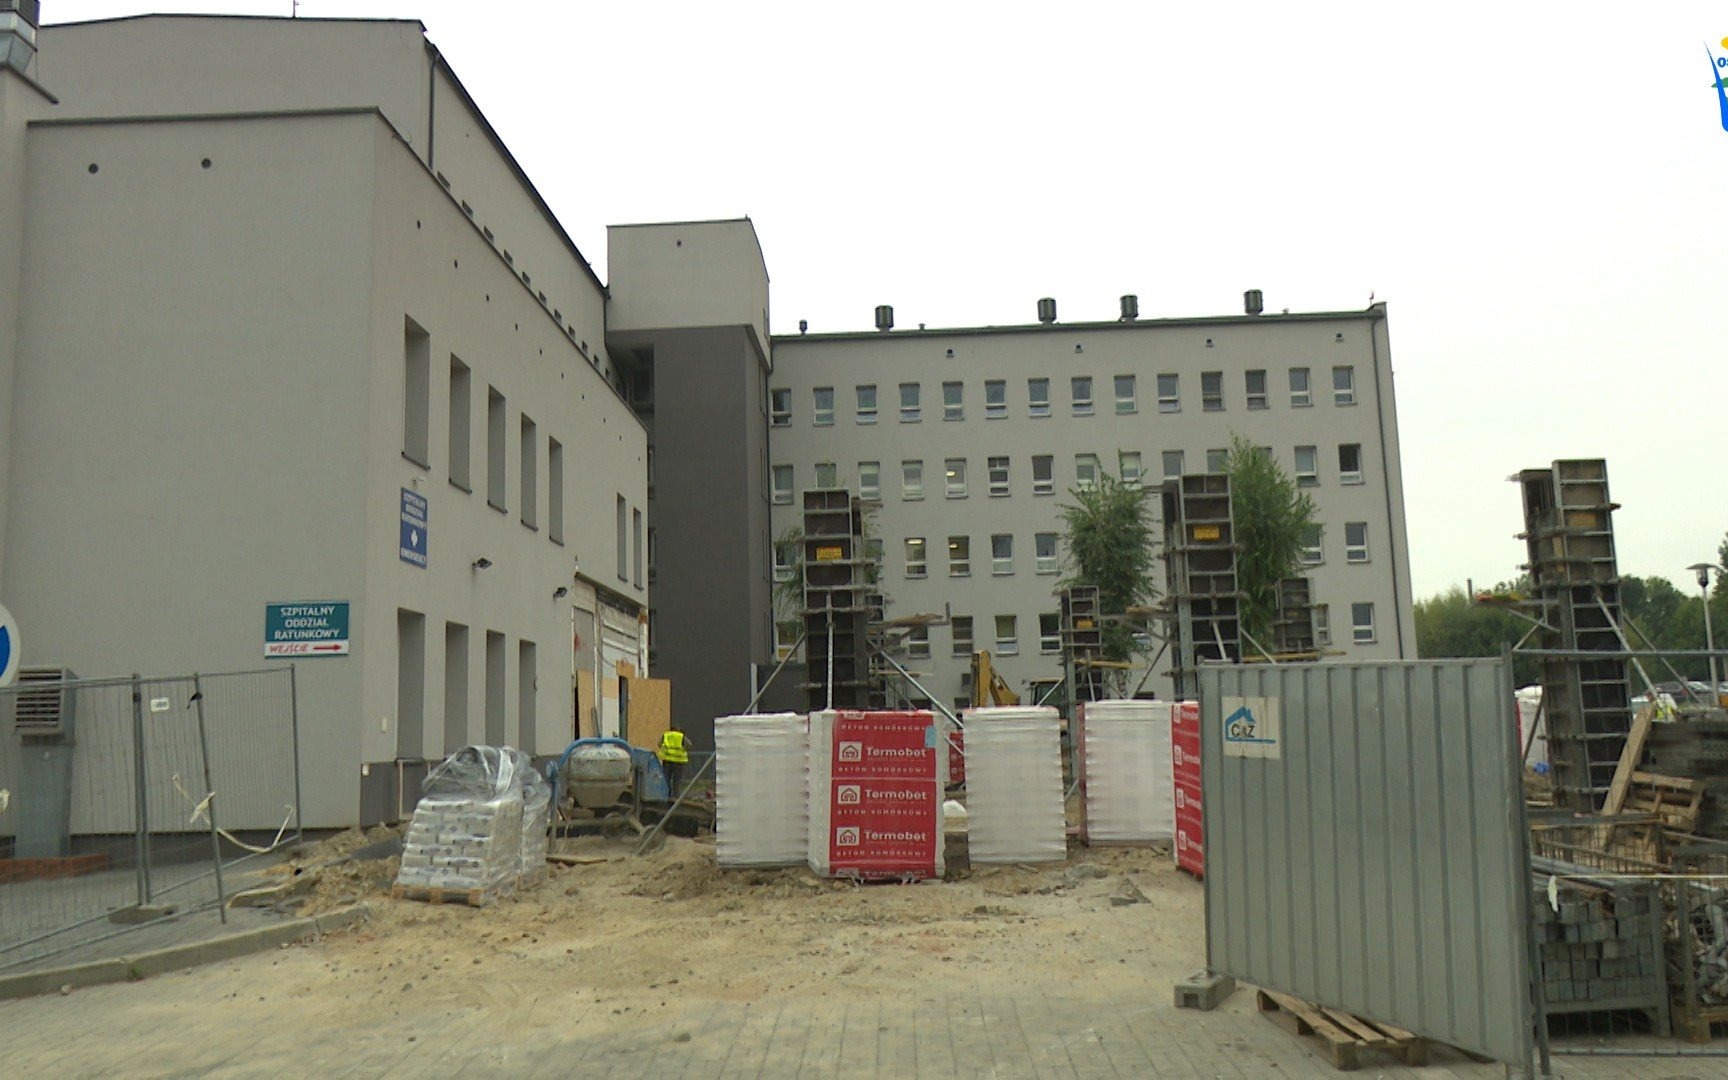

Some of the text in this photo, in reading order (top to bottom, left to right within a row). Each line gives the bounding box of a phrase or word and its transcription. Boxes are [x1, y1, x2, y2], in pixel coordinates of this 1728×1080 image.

[280, 605, 335, 617] SZPITALNY
[274, 628, 340, 640] RATUNKOWY
[865, 745, 927, 758] Termobet
[864, 789, 927, 800] Termobet
[864, 830, 927, 842] Termobet
